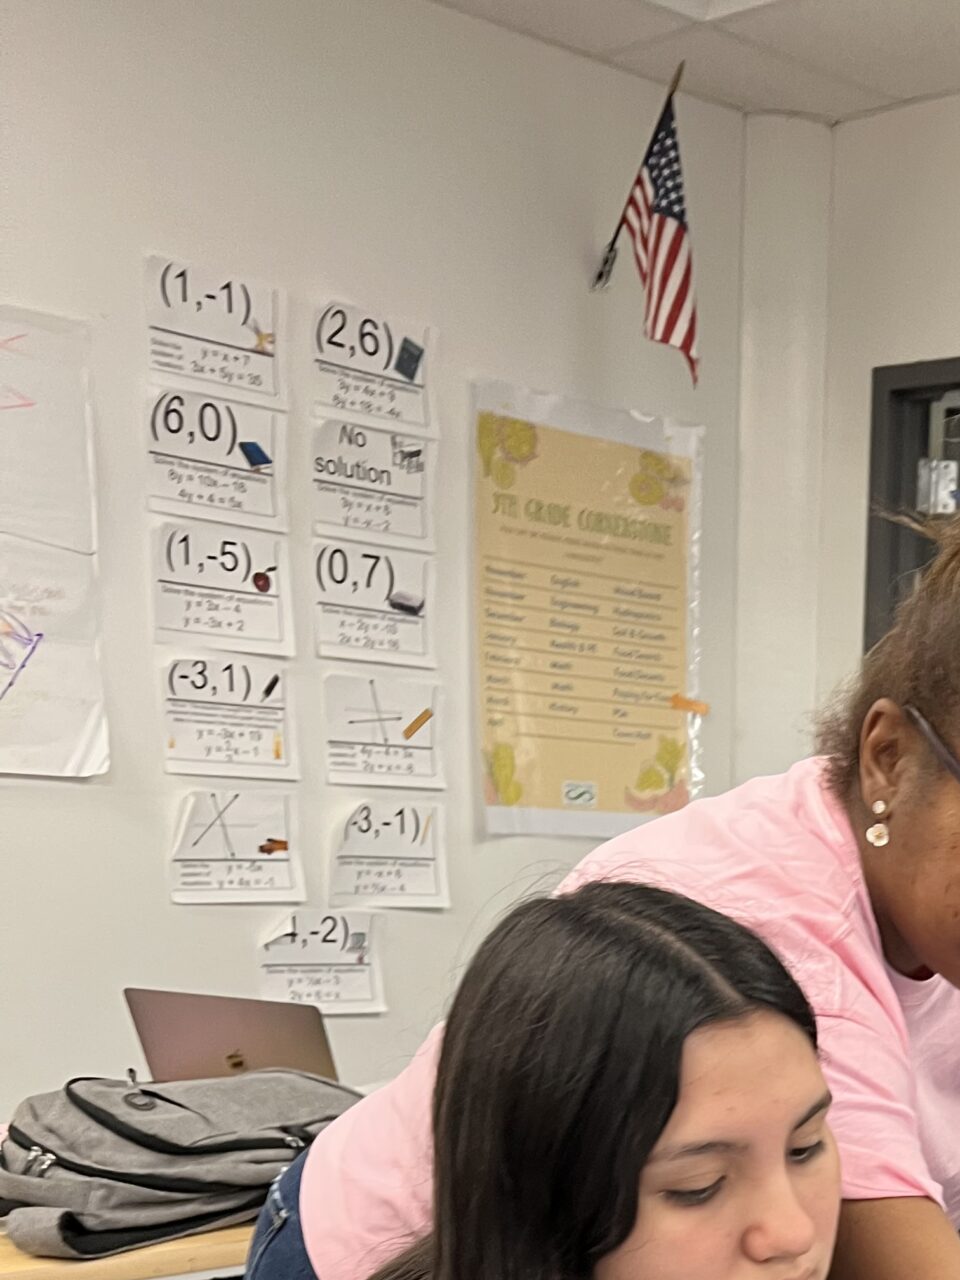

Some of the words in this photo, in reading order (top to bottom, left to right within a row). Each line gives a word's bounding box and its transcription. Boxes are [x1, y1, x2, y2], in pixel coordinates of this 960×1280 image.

[315, 304, 394, 370] (2,6)
[150, 391, 238, 456] (6,0)
[338, 424, 367, 448] No
[313, 456, 392, 487] solution
[166, 529, 251, 582] (1,-5)
[315, 545, 395, 601] (0,7)
[167, 660, 252, 702] (-3,1)
